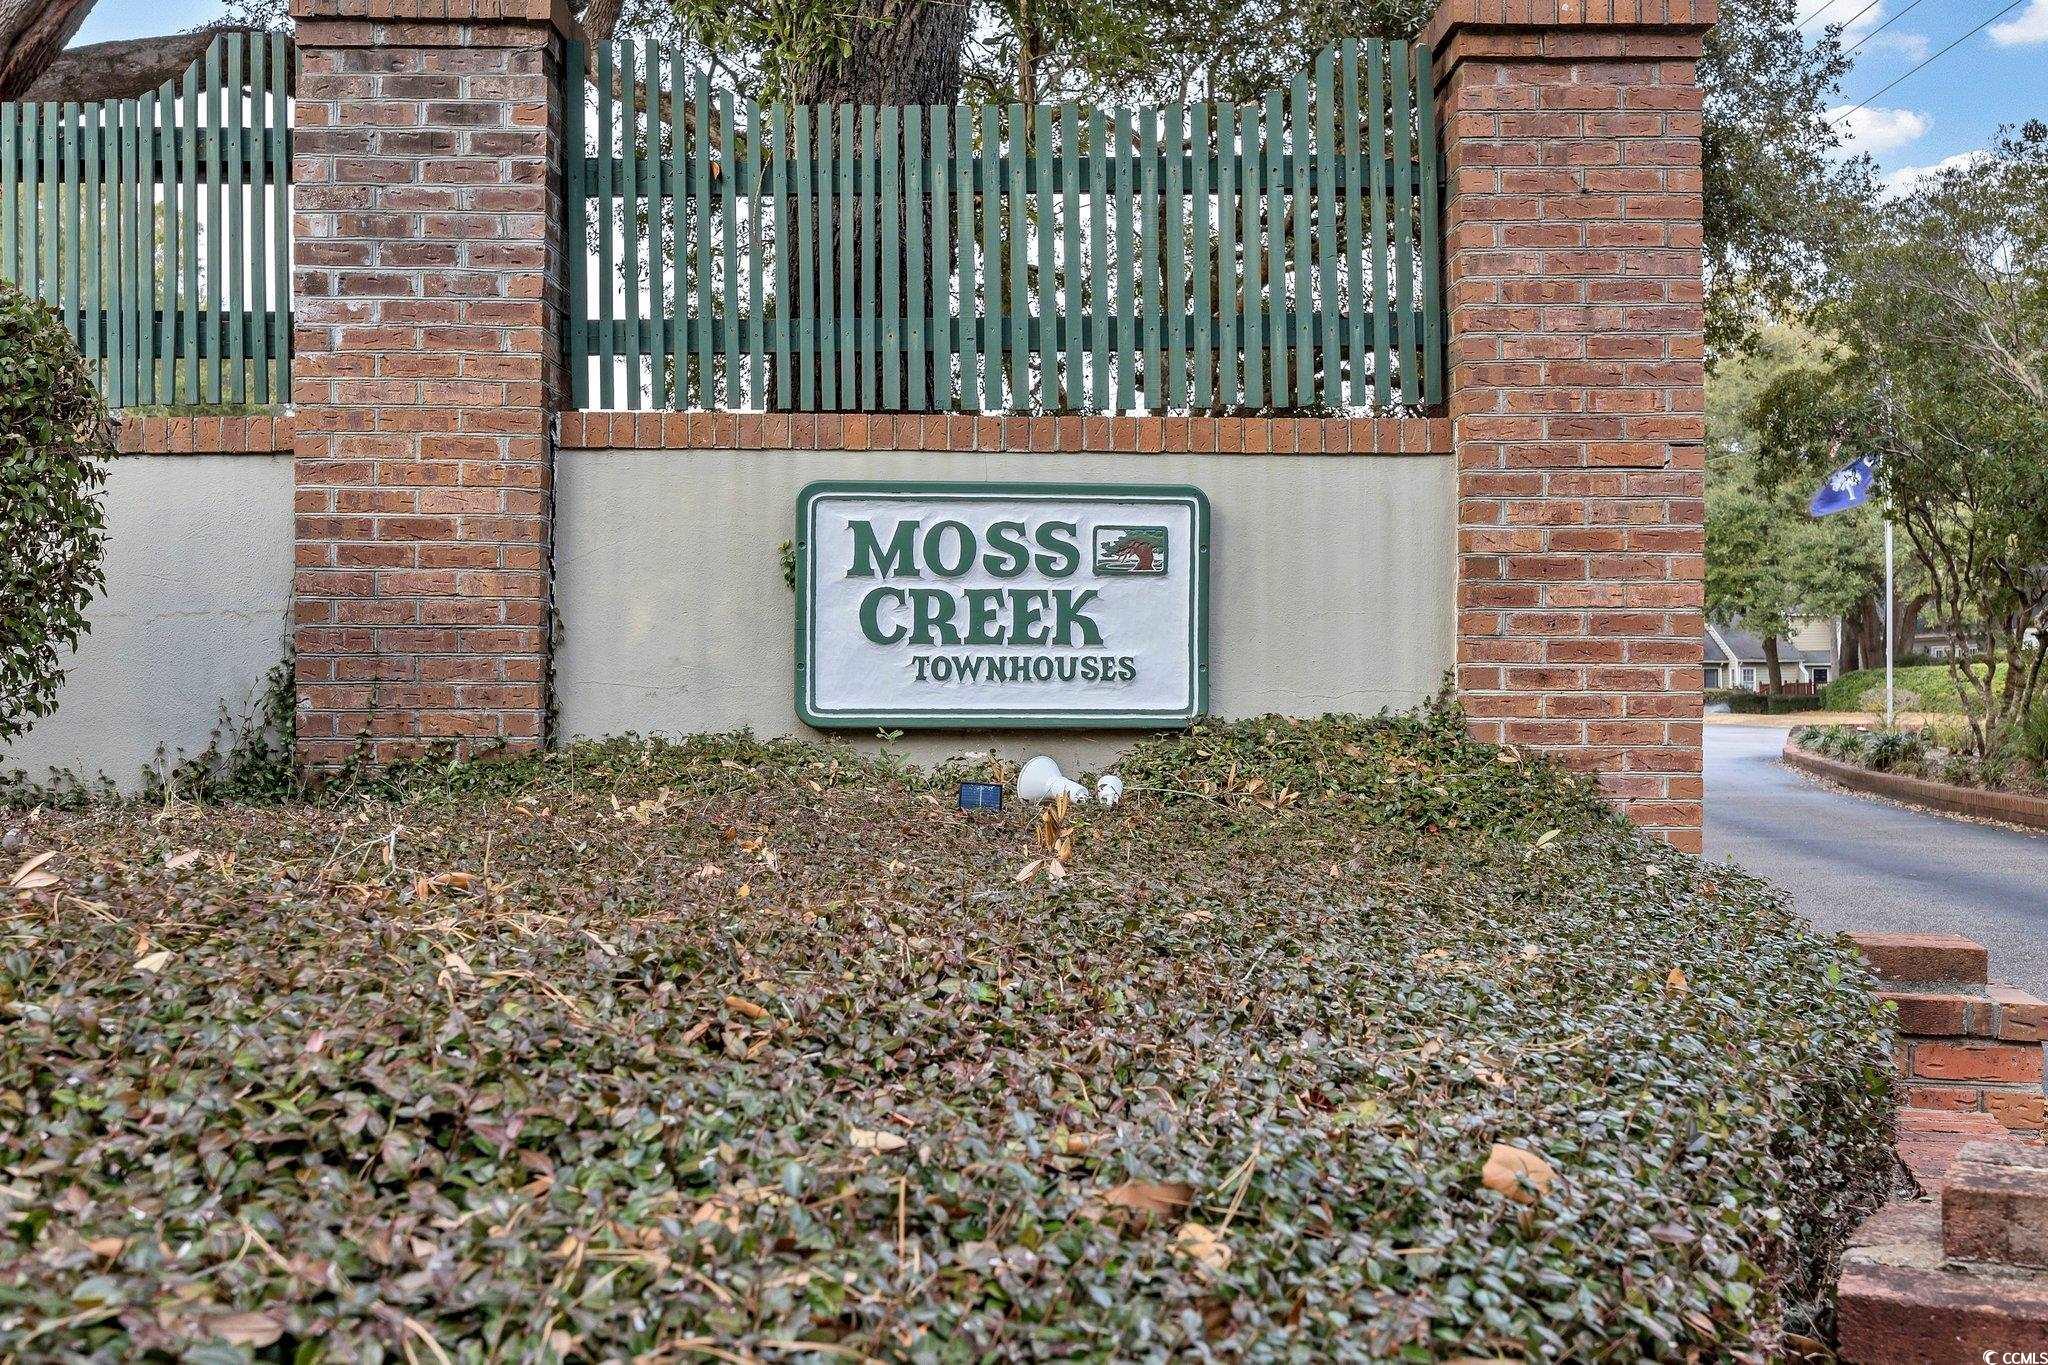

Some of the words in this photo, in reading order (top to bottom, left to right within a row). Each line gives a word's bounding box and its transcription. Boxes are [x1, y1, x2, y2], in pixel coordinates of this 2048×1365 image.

[846, 520, 1080, 579] MOSS
[859, 586, 1104, 646] CREEK
[912, 655, 1137, 682] TOWNHOUSES
